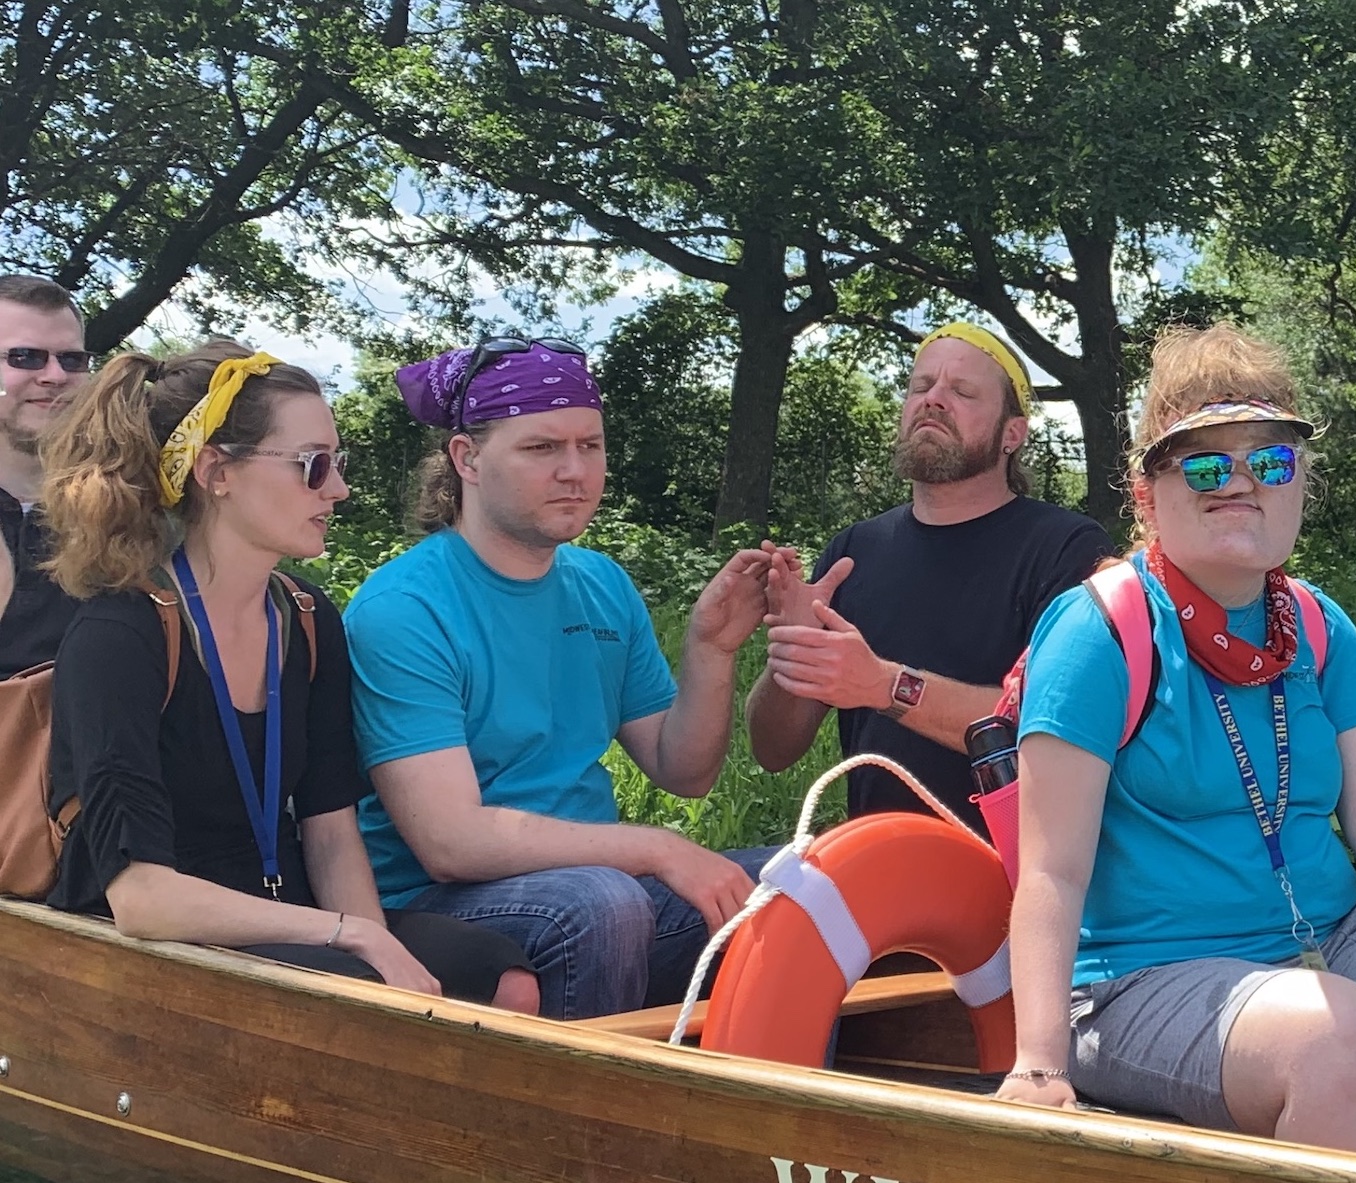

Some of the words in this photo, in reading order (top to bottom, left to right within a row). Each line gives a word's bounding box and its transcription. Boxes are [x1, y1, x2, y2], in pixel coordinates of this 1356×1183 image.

[1213, 693, 1253, 779] UNIVERSITY
[1272, 694, 1288, 751] BETHEL
[1246, 778, 1274, 837] BETHEL
[1273, 753, 1290, 833] UNIVERSITY
